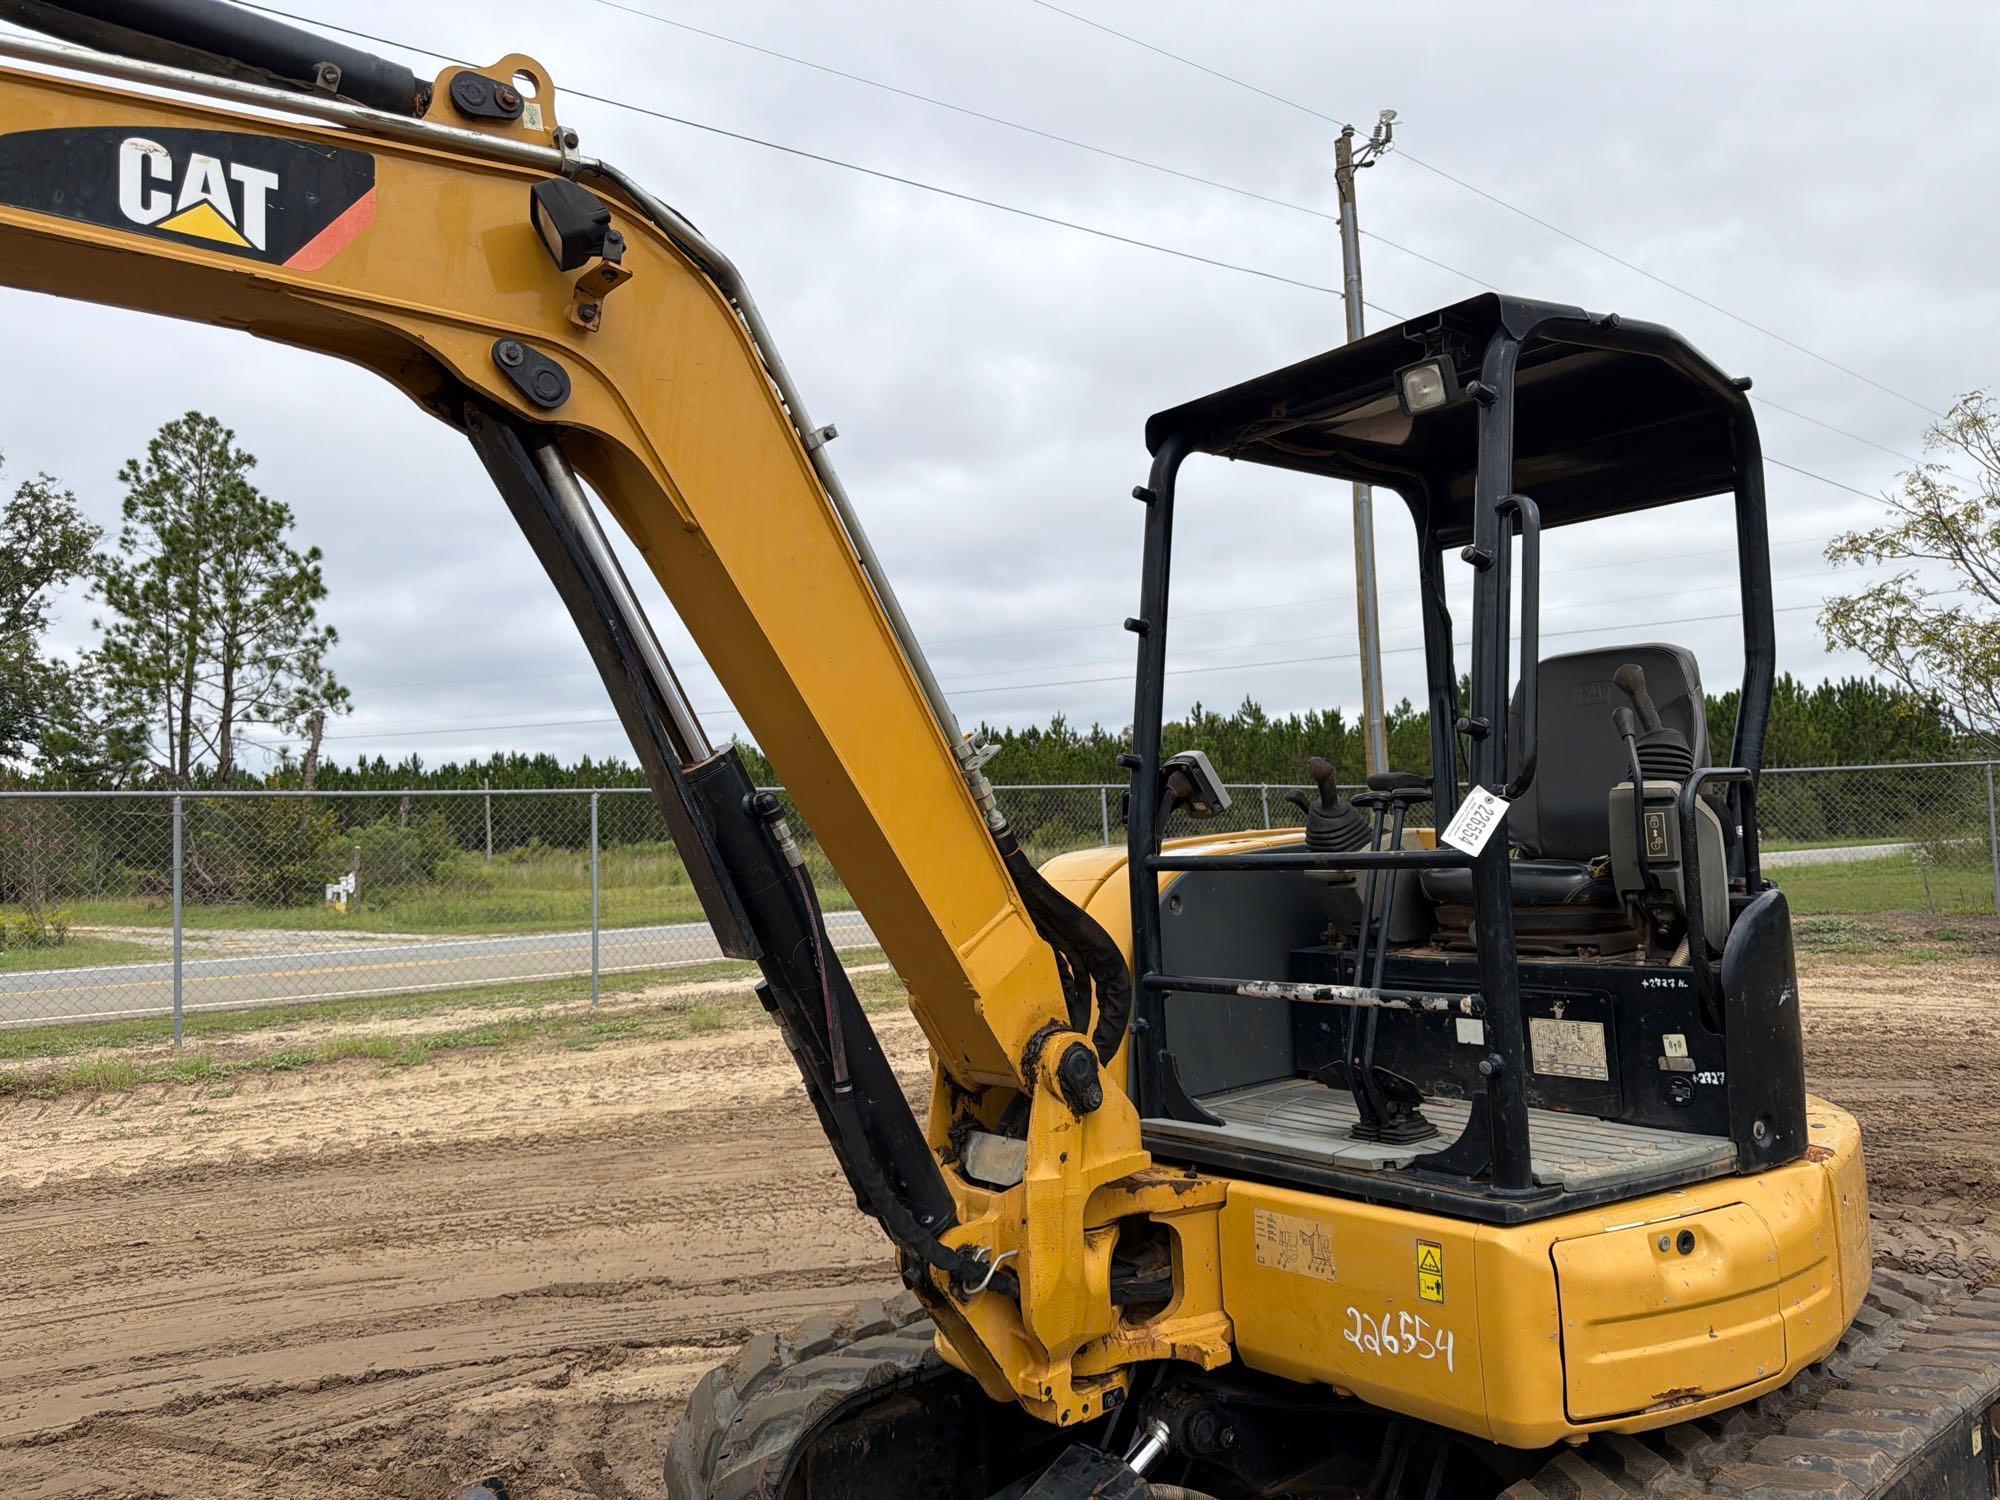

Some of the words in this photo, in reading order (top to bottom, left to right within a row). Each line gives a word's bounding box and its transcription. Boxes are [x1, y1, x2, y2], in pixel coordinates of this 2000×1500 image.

[119, 137, 279, 251] CAT
[1458, 804, 1494, 846] 226554
[1343, 1306, 1454, 1373] 226554
